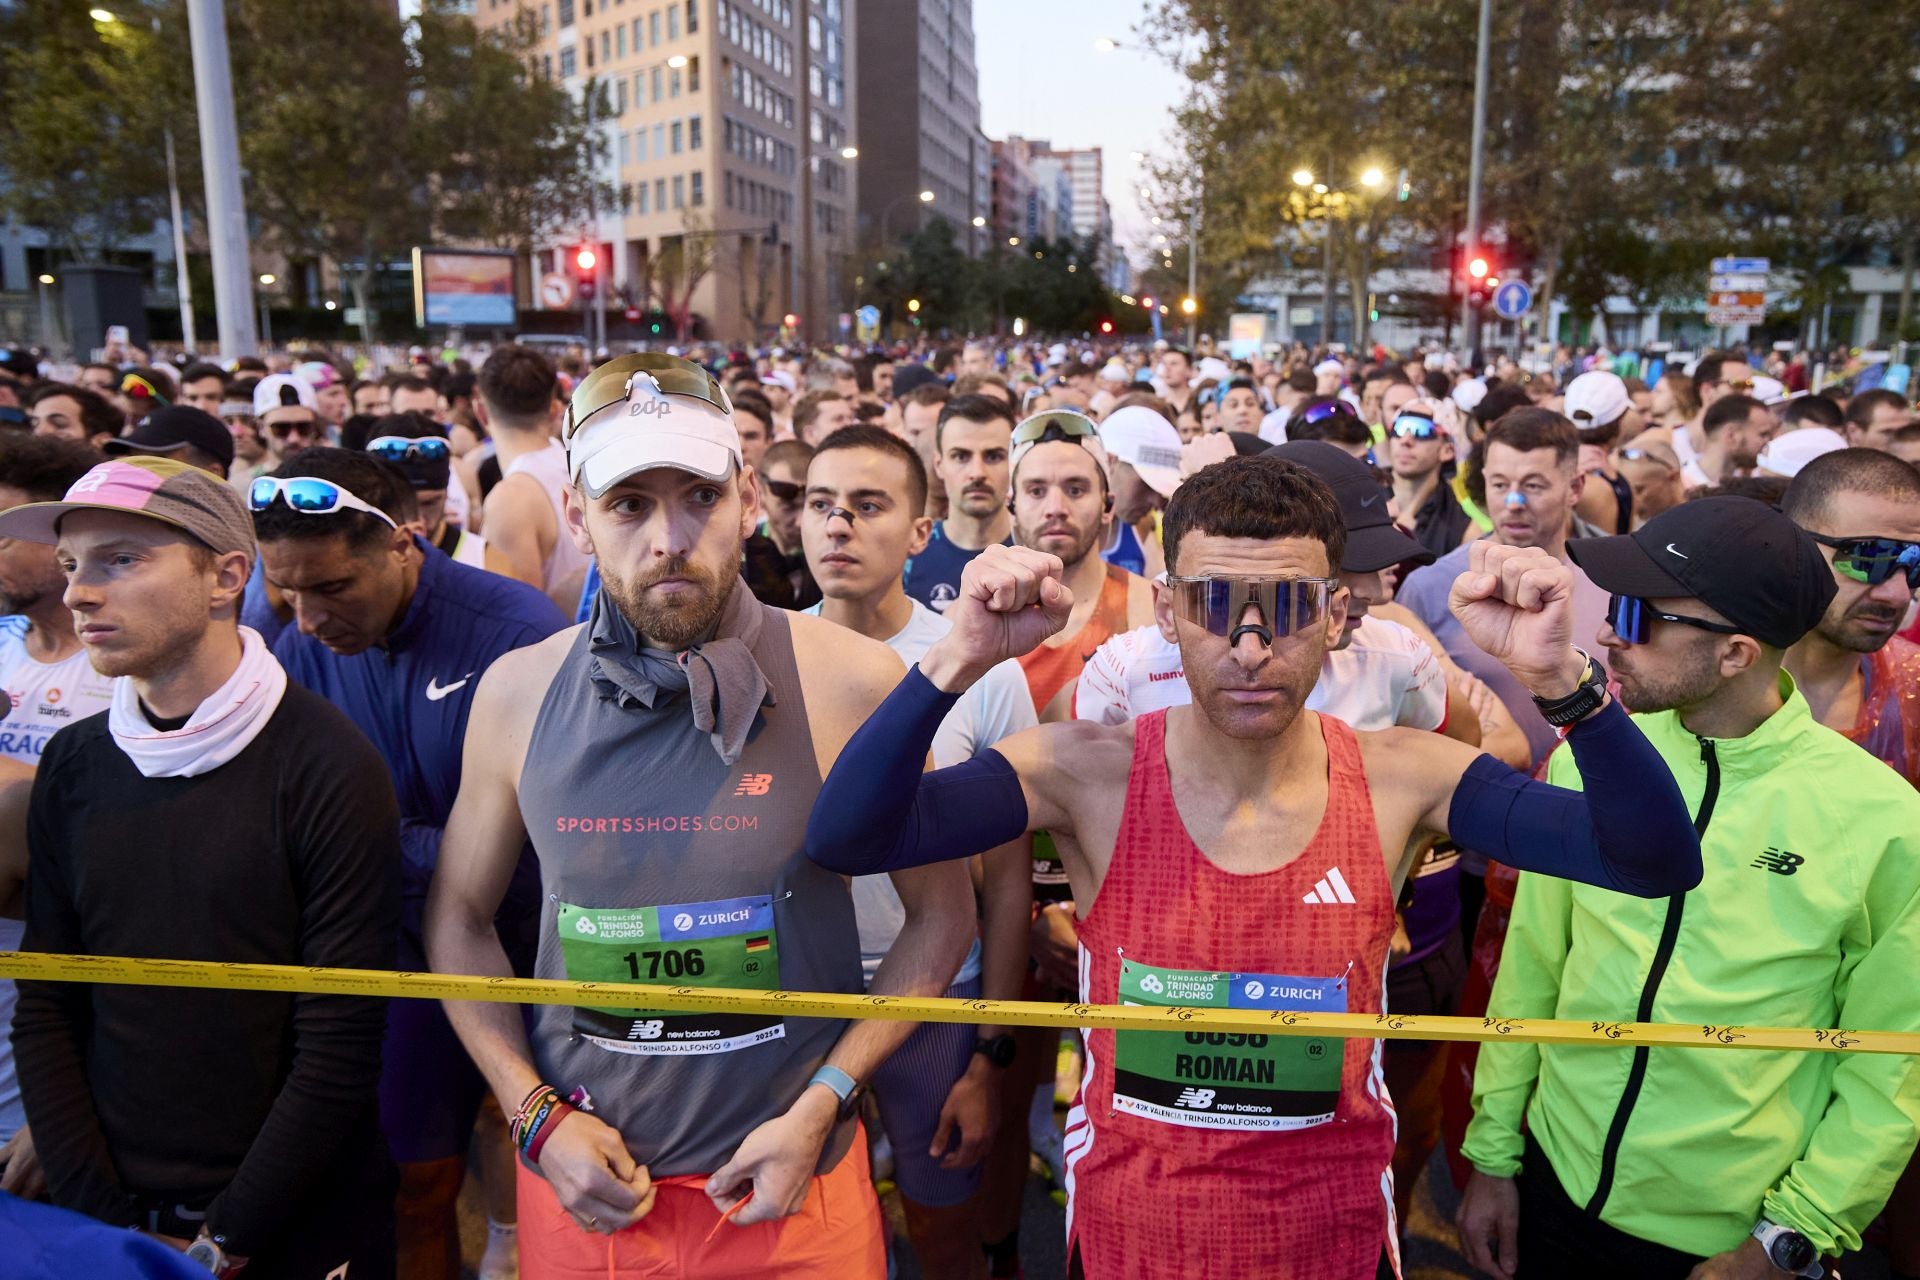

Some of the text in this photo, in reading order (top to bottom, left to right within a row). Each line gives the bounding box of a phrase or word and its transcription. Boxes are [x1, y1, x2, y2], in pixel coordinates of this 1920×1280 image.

[629, 396, 672, 419] edp
[556, 815, 759, 832] SPORTSSHOES.COM
[597, 913, 642, 922] FUNDACIÓN
[698, 909, 750, 926] ZURICH
[599, 921, 644, 931] TRINIDAD
[600, 929, 644, 938] ALFONSO
[623, 948, 705, 980] 1706
[745, 961, 759, 972] 02
[1167, 981, 1214, 992] TRINIDAD
[1166, 990, 1214, 1000] ALFONSO
[1270, 987, 1322, 1000] ZURICH
[667, 1031, 682, 1039] new
[685, 1029, 720, 1038] balance
[679, 1043, 721, 1051] ALFONSO
[755, 1031, 773, 1041] 2025
[1309, 1046, 1322, 1055] 02
[1175, 1053, 1275, 1084] ROMAN
[1217, 1103, 1234, 1111] new
[1236, 1103, 1272, 1113] balance
[1135, 1103, 1149, 1112] 42K
[1150, 1106, 1182, 1119] VALENCIA
[1184, 1114, 1225, 1125] TRINIDAD
[1226, 1119, 1270, 1127] ALFONSO
